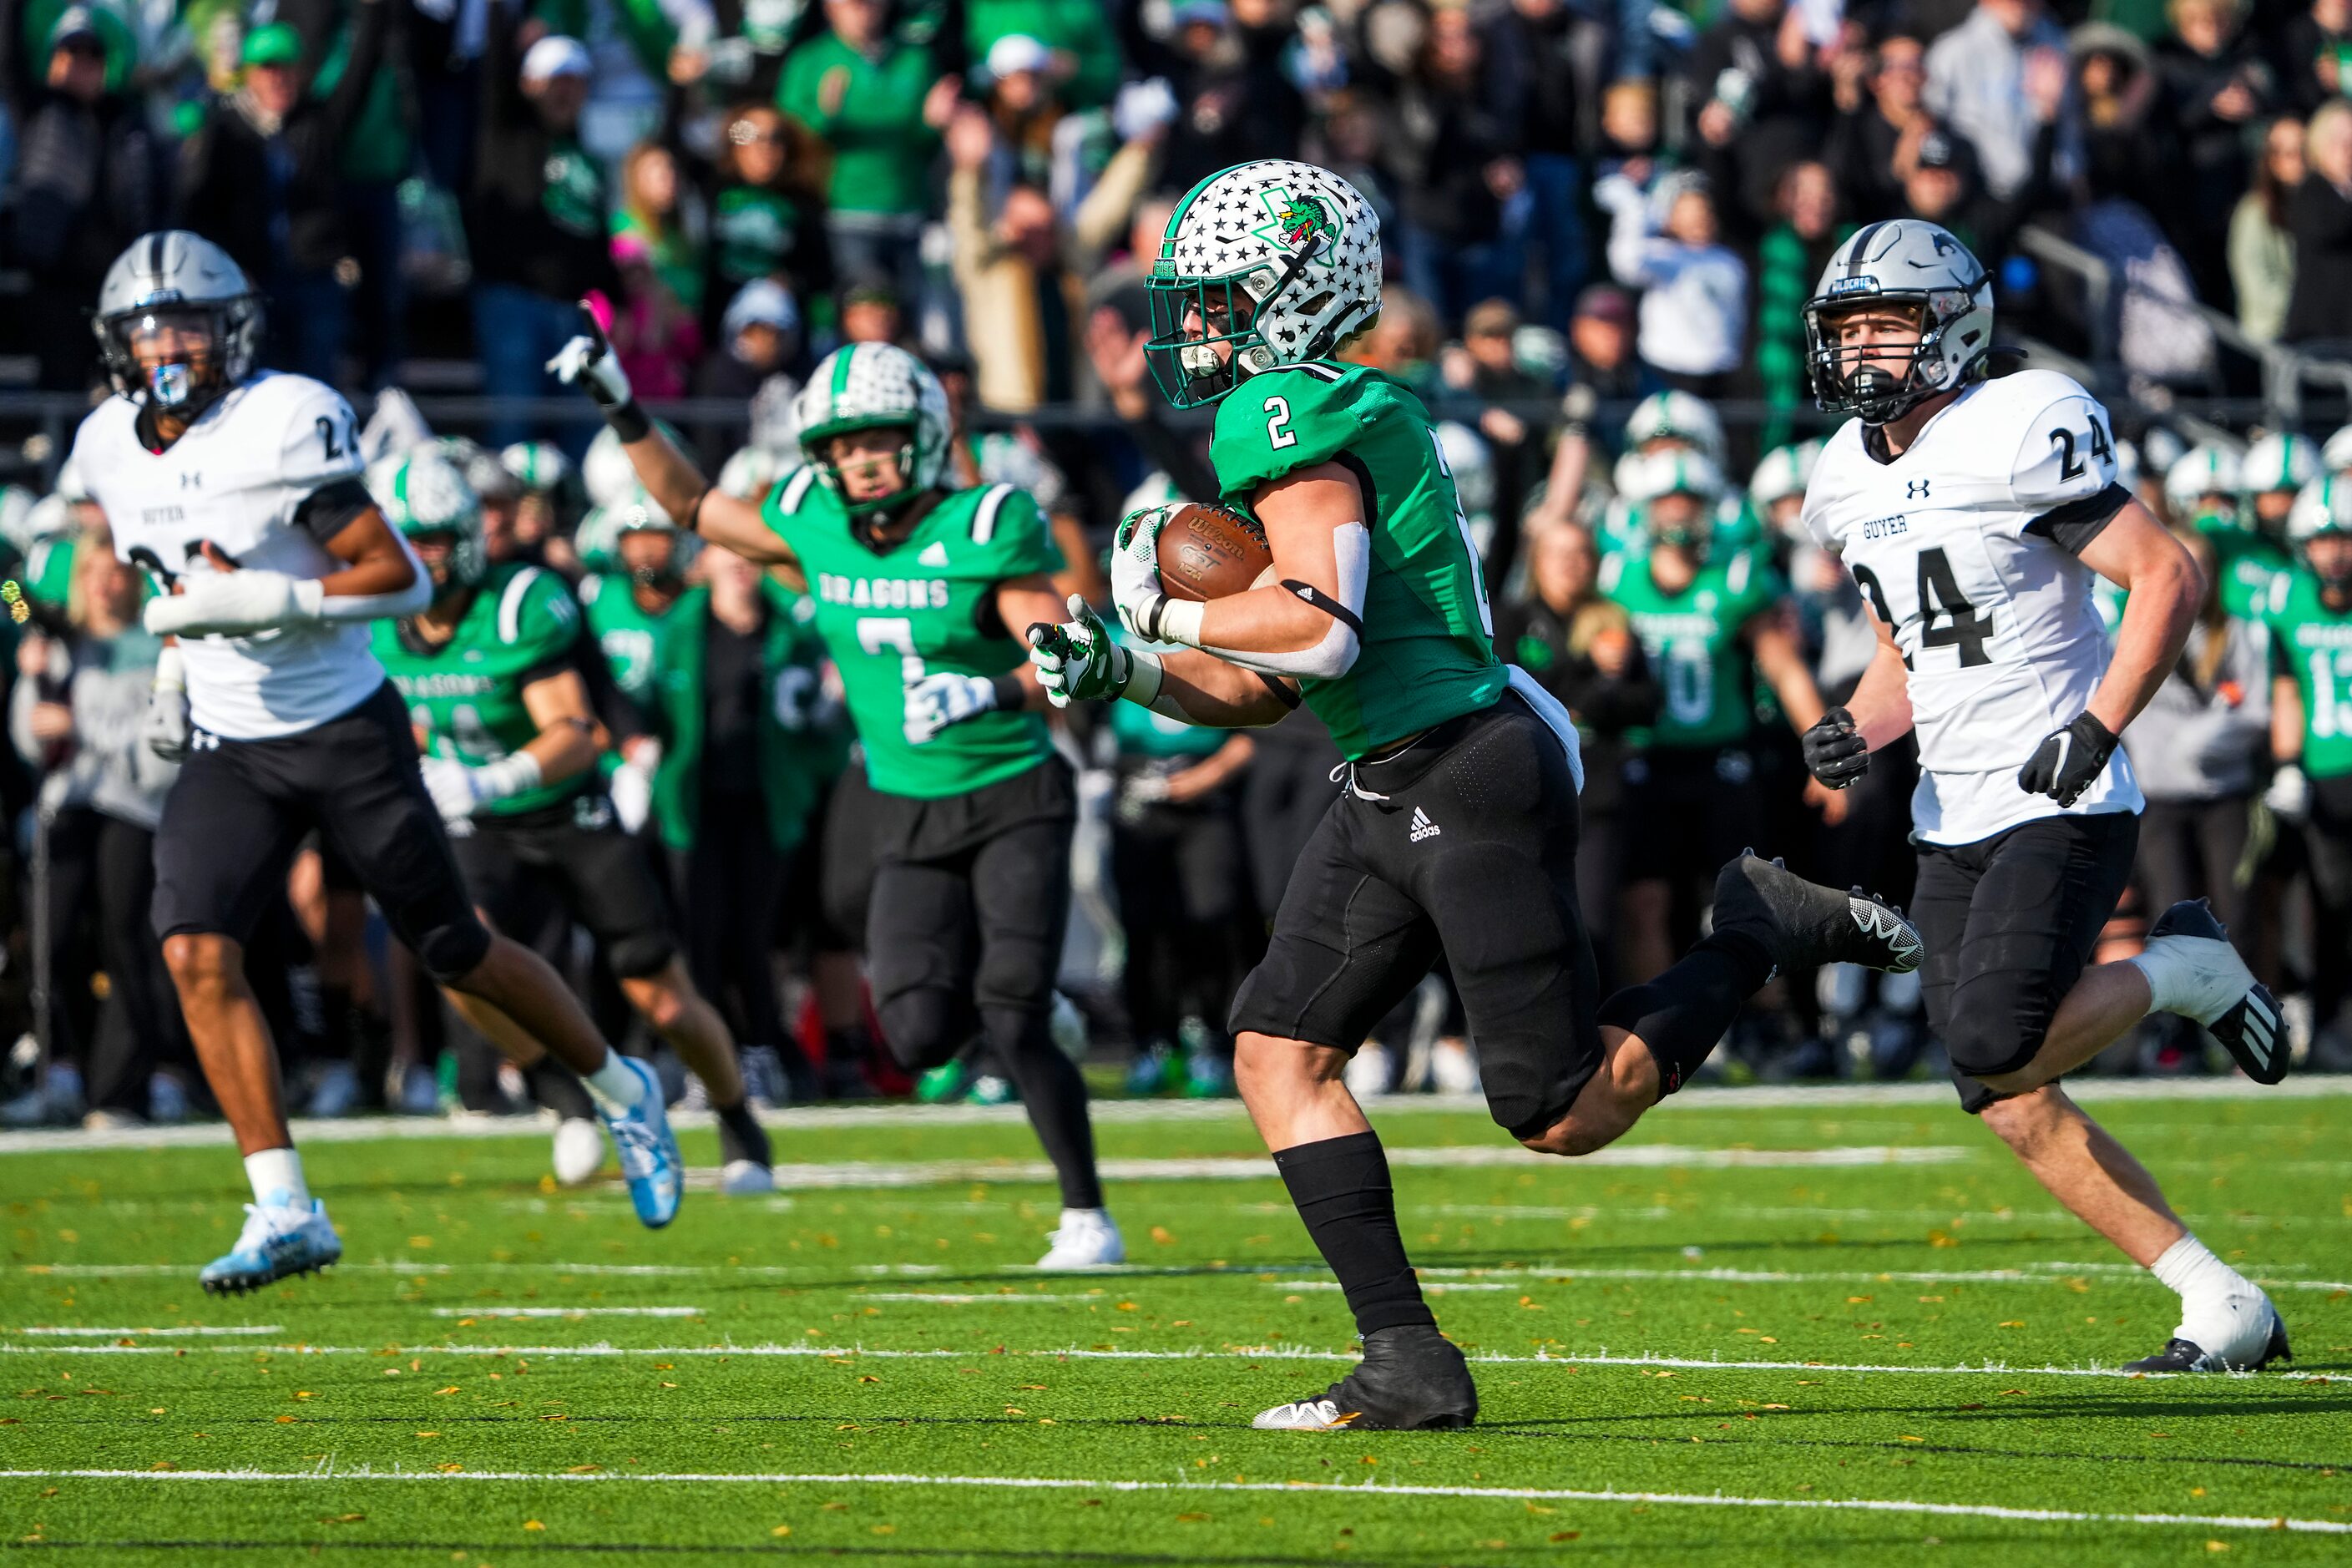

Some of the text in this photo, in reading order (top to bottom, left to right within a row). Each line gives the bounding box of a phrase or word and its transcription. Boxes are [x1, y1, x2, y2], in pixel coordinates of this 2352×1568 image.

[1263, 396, 1298, 451] 2
[2048, 413, 2113, 484] 24
[1187, 516, 1245, 562] Wilson
[1864, 514, 1908, 539] GUYER
[1182, 544, 1222, 569] GST
[818, 572, 948, 609] DRAGONS
[856, 617, 926, 685] 7
[1409, 824, 1441, 842] adidas
